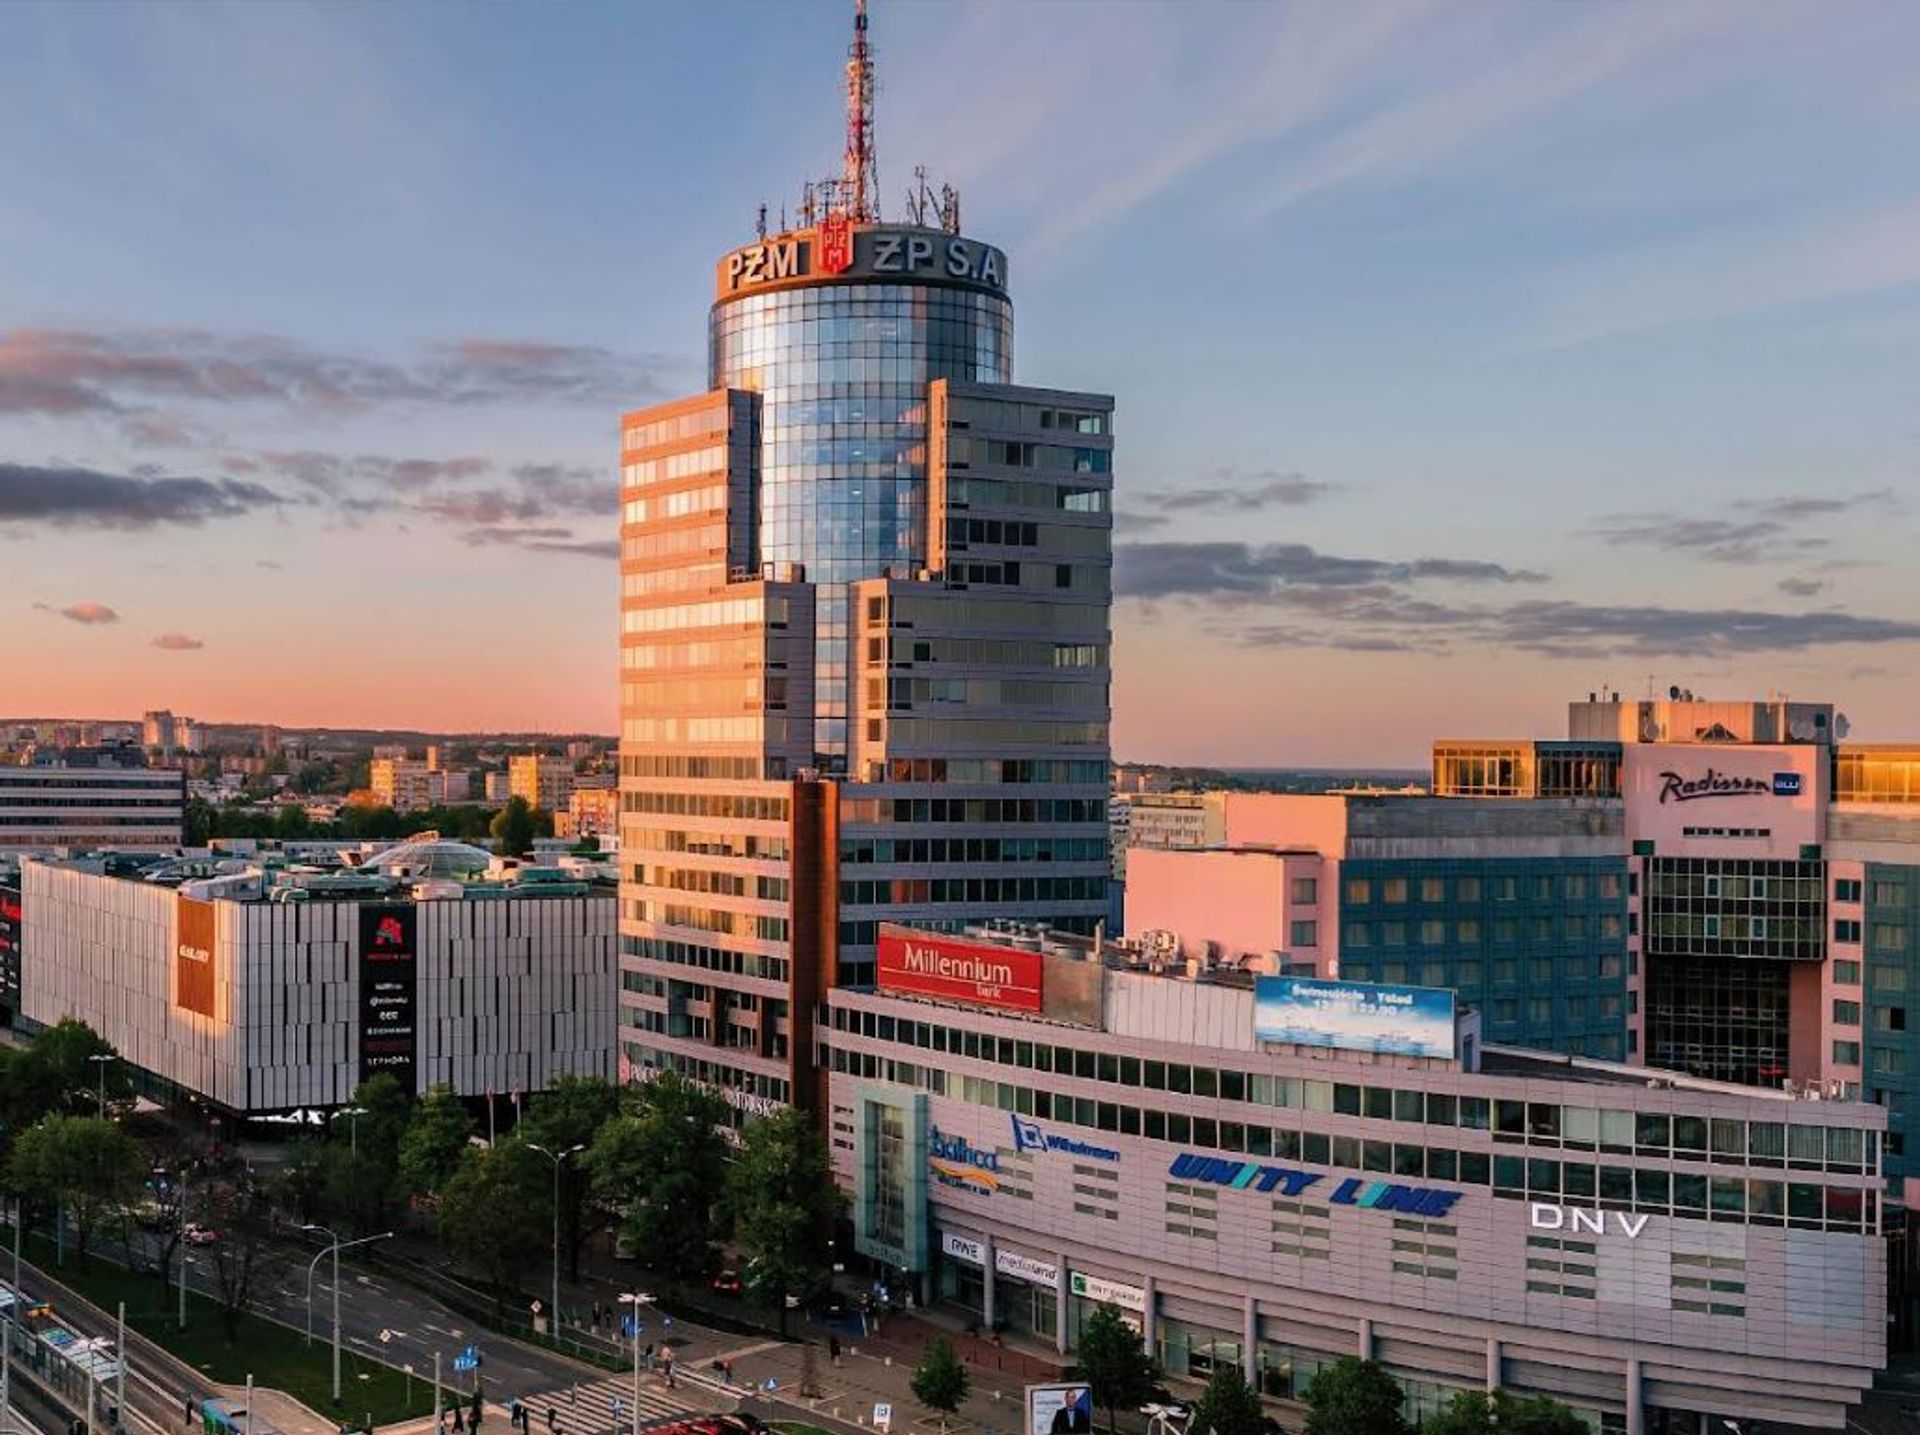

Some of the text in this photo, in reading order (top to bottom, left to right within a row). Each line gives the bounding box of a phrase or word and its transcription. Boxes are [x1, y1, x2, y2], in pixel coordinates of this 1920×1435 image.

[1659, 767, 1771, 804] Radisson
[904, 942, 1013, 985] Millennium
[1168, 1152, 1464, 1218] UNITY LINE
[1531, 1202, 1650, 1239] DNV
